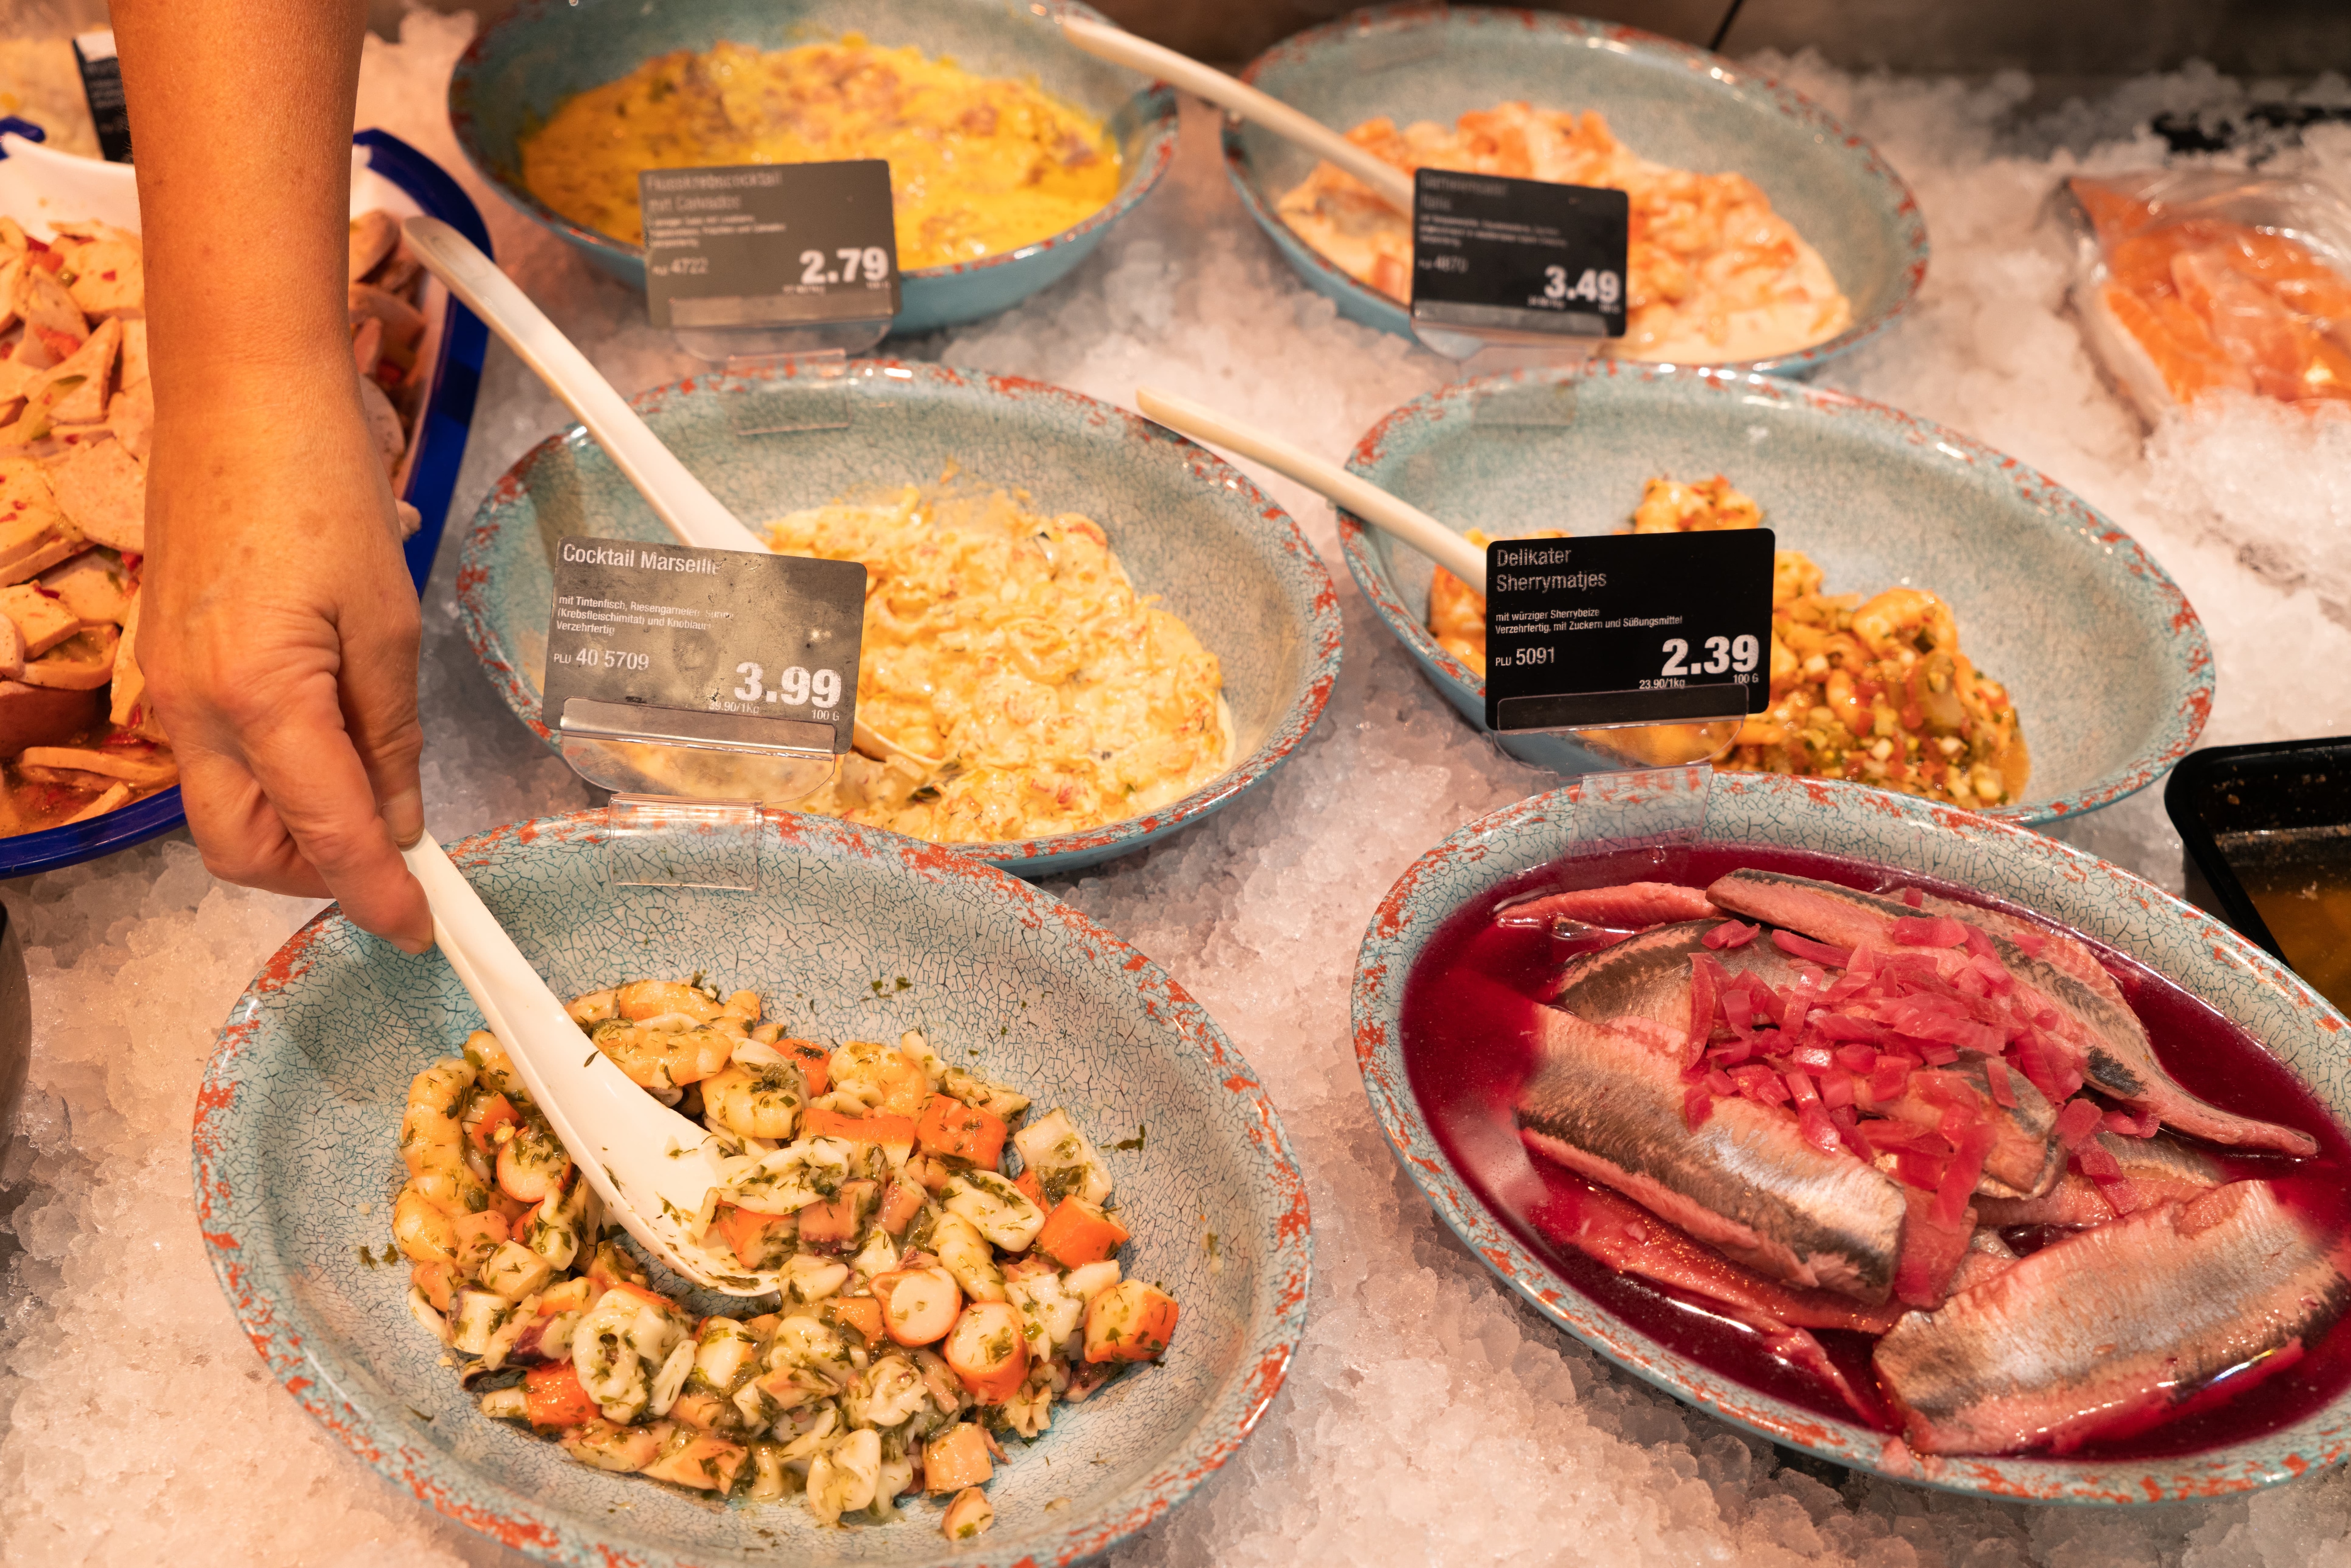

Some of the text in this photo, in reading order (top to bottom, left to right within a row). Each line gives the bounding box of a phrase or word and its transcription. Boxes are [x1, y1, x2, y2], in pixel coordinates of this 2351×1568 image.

[799, 246, 889, 284] 2.79
[1544, 265, 1621, 303] 3.49
[564, 544, 634, 567] Cocktail
[1497, 548, 1572, 567] Delikater
[1496, 570, 1607, 594] Sherrymatjes
[559, 596, 574, 605] mit
[576, 596, 627, 611] Tintenfisch,
[647, 617, 664, 627] und
[1496, 607, 1600, 622] mit würziger Sherrybeize
[557, 620, 615, 636] Verzehrfertig
[1495, 615, 1682, 634] Verzehrfertig, mit Zuckern und Süßungsmittel
[554, 648, 649, 670] PLU 40 5709
[1495, 646, 1554, 667] PLU 5091
[1661, 634, 1759, 676] 2.39
[734, 662, 841, 708] 3.99
[1639, 677, 1685, 689] 23.90/1kg
[1733, 673, 1759, 684] 100 G
[812, 709, 840, 721] 100 G
